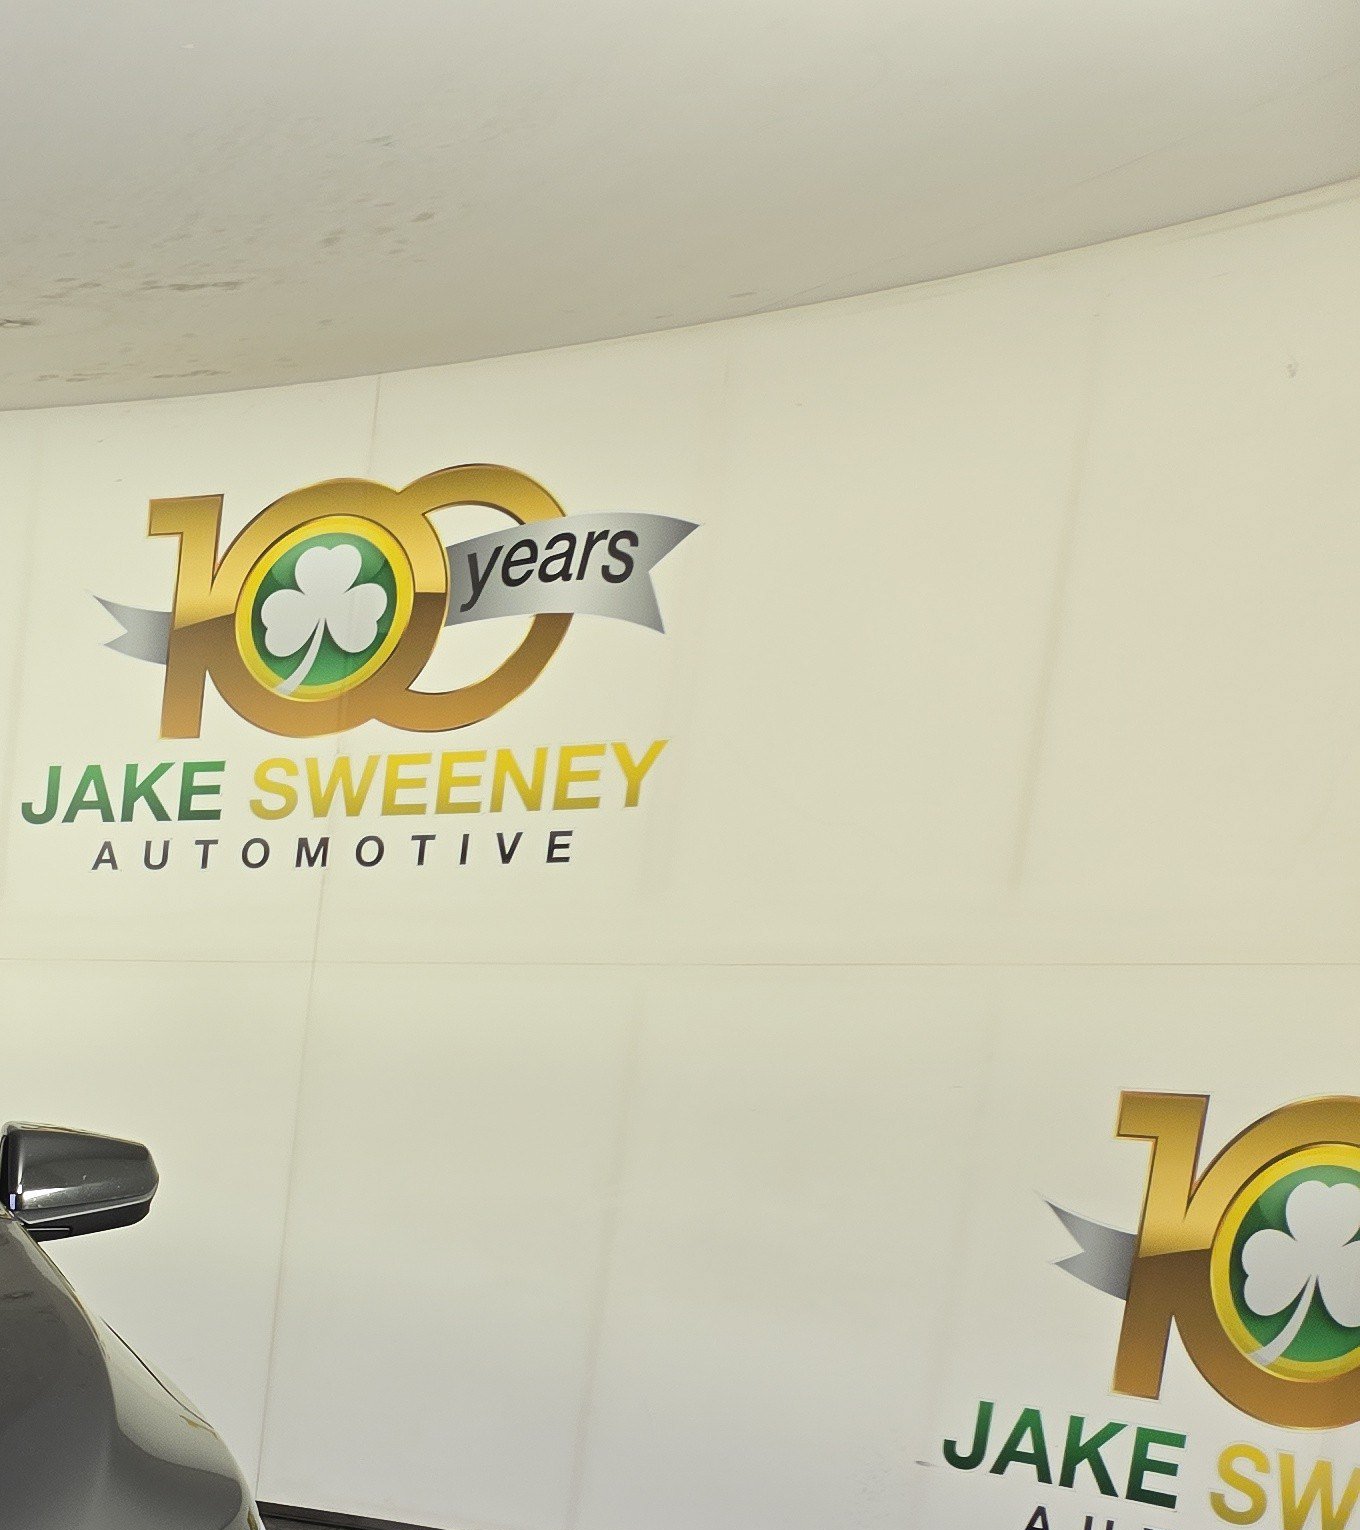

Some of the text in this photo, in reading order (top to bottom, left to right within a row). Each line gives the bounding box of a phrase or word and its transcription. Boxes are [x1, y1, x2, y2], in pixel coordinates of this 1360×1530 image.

[147, 463, 640, 739] 100 years
[21, 739, 669, 826] JAKE SWEENEY
[91, 829, 575, 873] AUTOMOTIVE
[1113, 1090, 1360, 1429] 10
[942, 1400, 1187, 1509] JAKE
